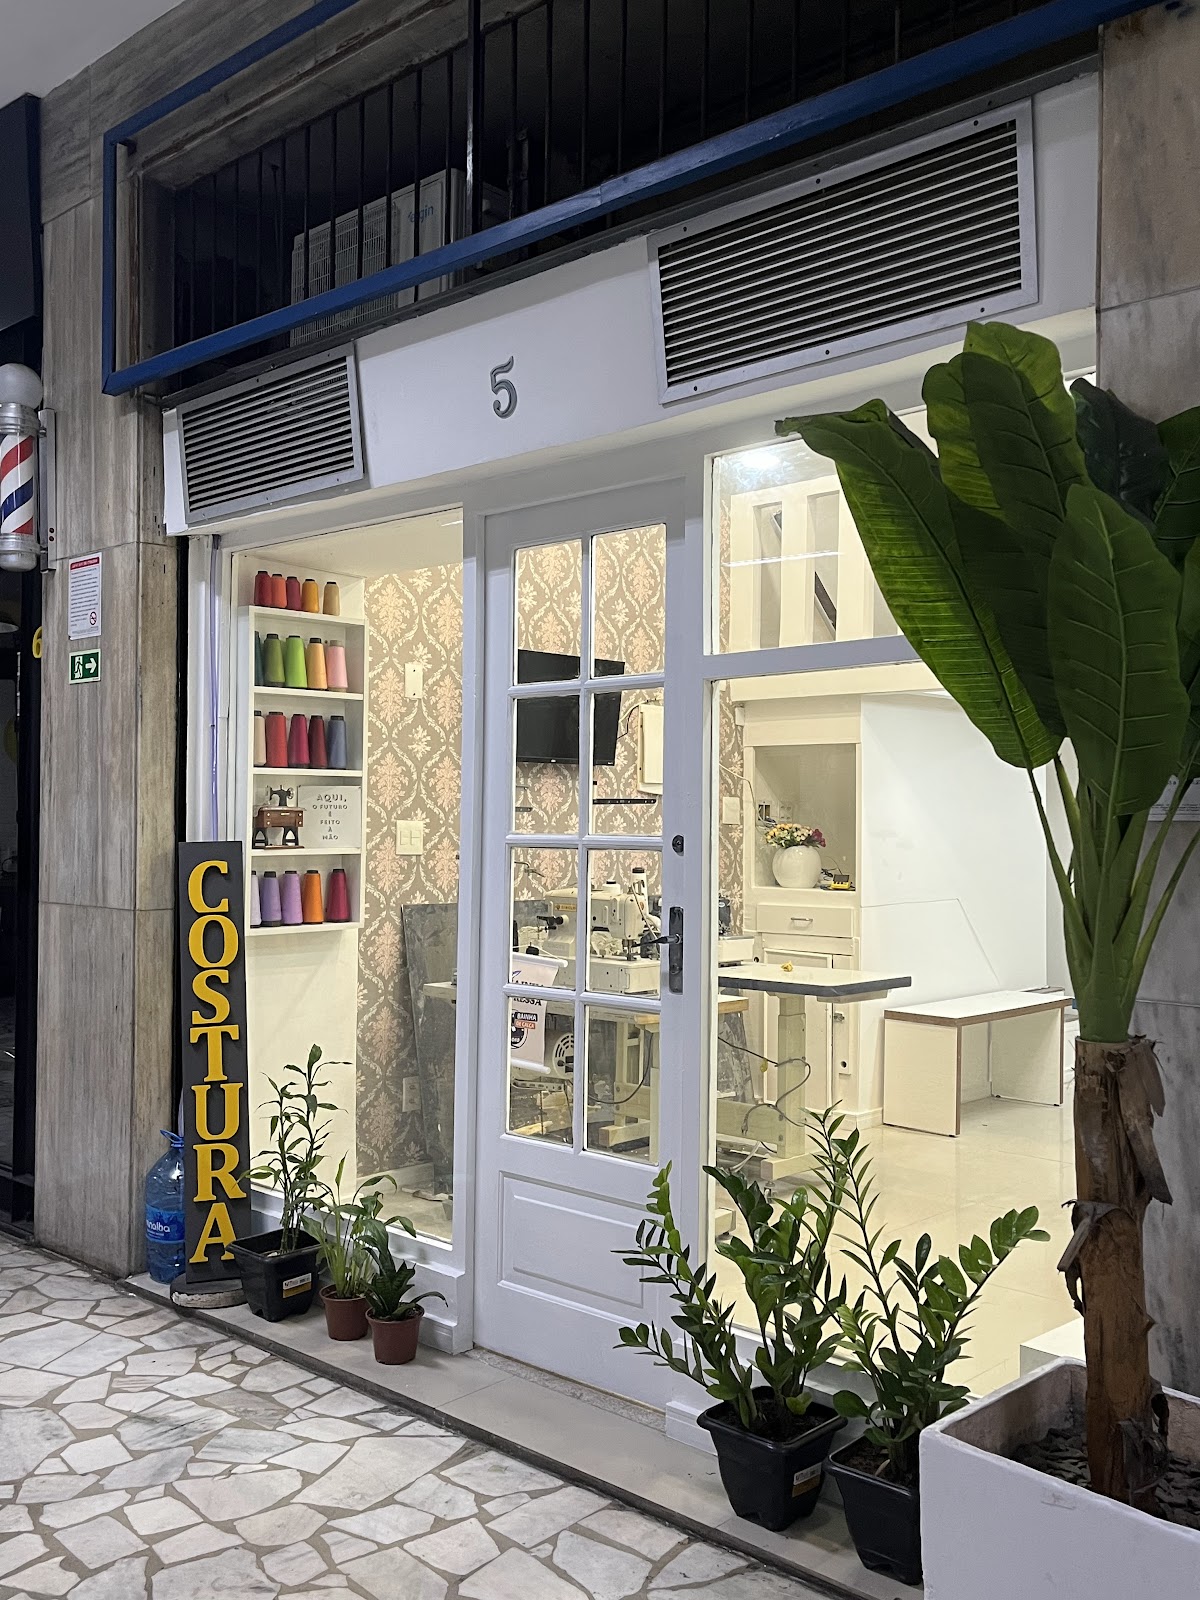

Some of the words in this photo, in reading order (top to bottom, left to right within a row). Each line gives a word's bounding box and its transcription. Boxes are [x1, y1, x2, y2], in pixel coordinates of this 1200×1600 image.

[409, 205, 434, 223] egin
[489, 355, 518, 419] 5
[316, 794, 347, 803] AQUI,
[516, 1013, 537, 1021] BAINHA
[187, 859, 247, 1264] COSTURA
